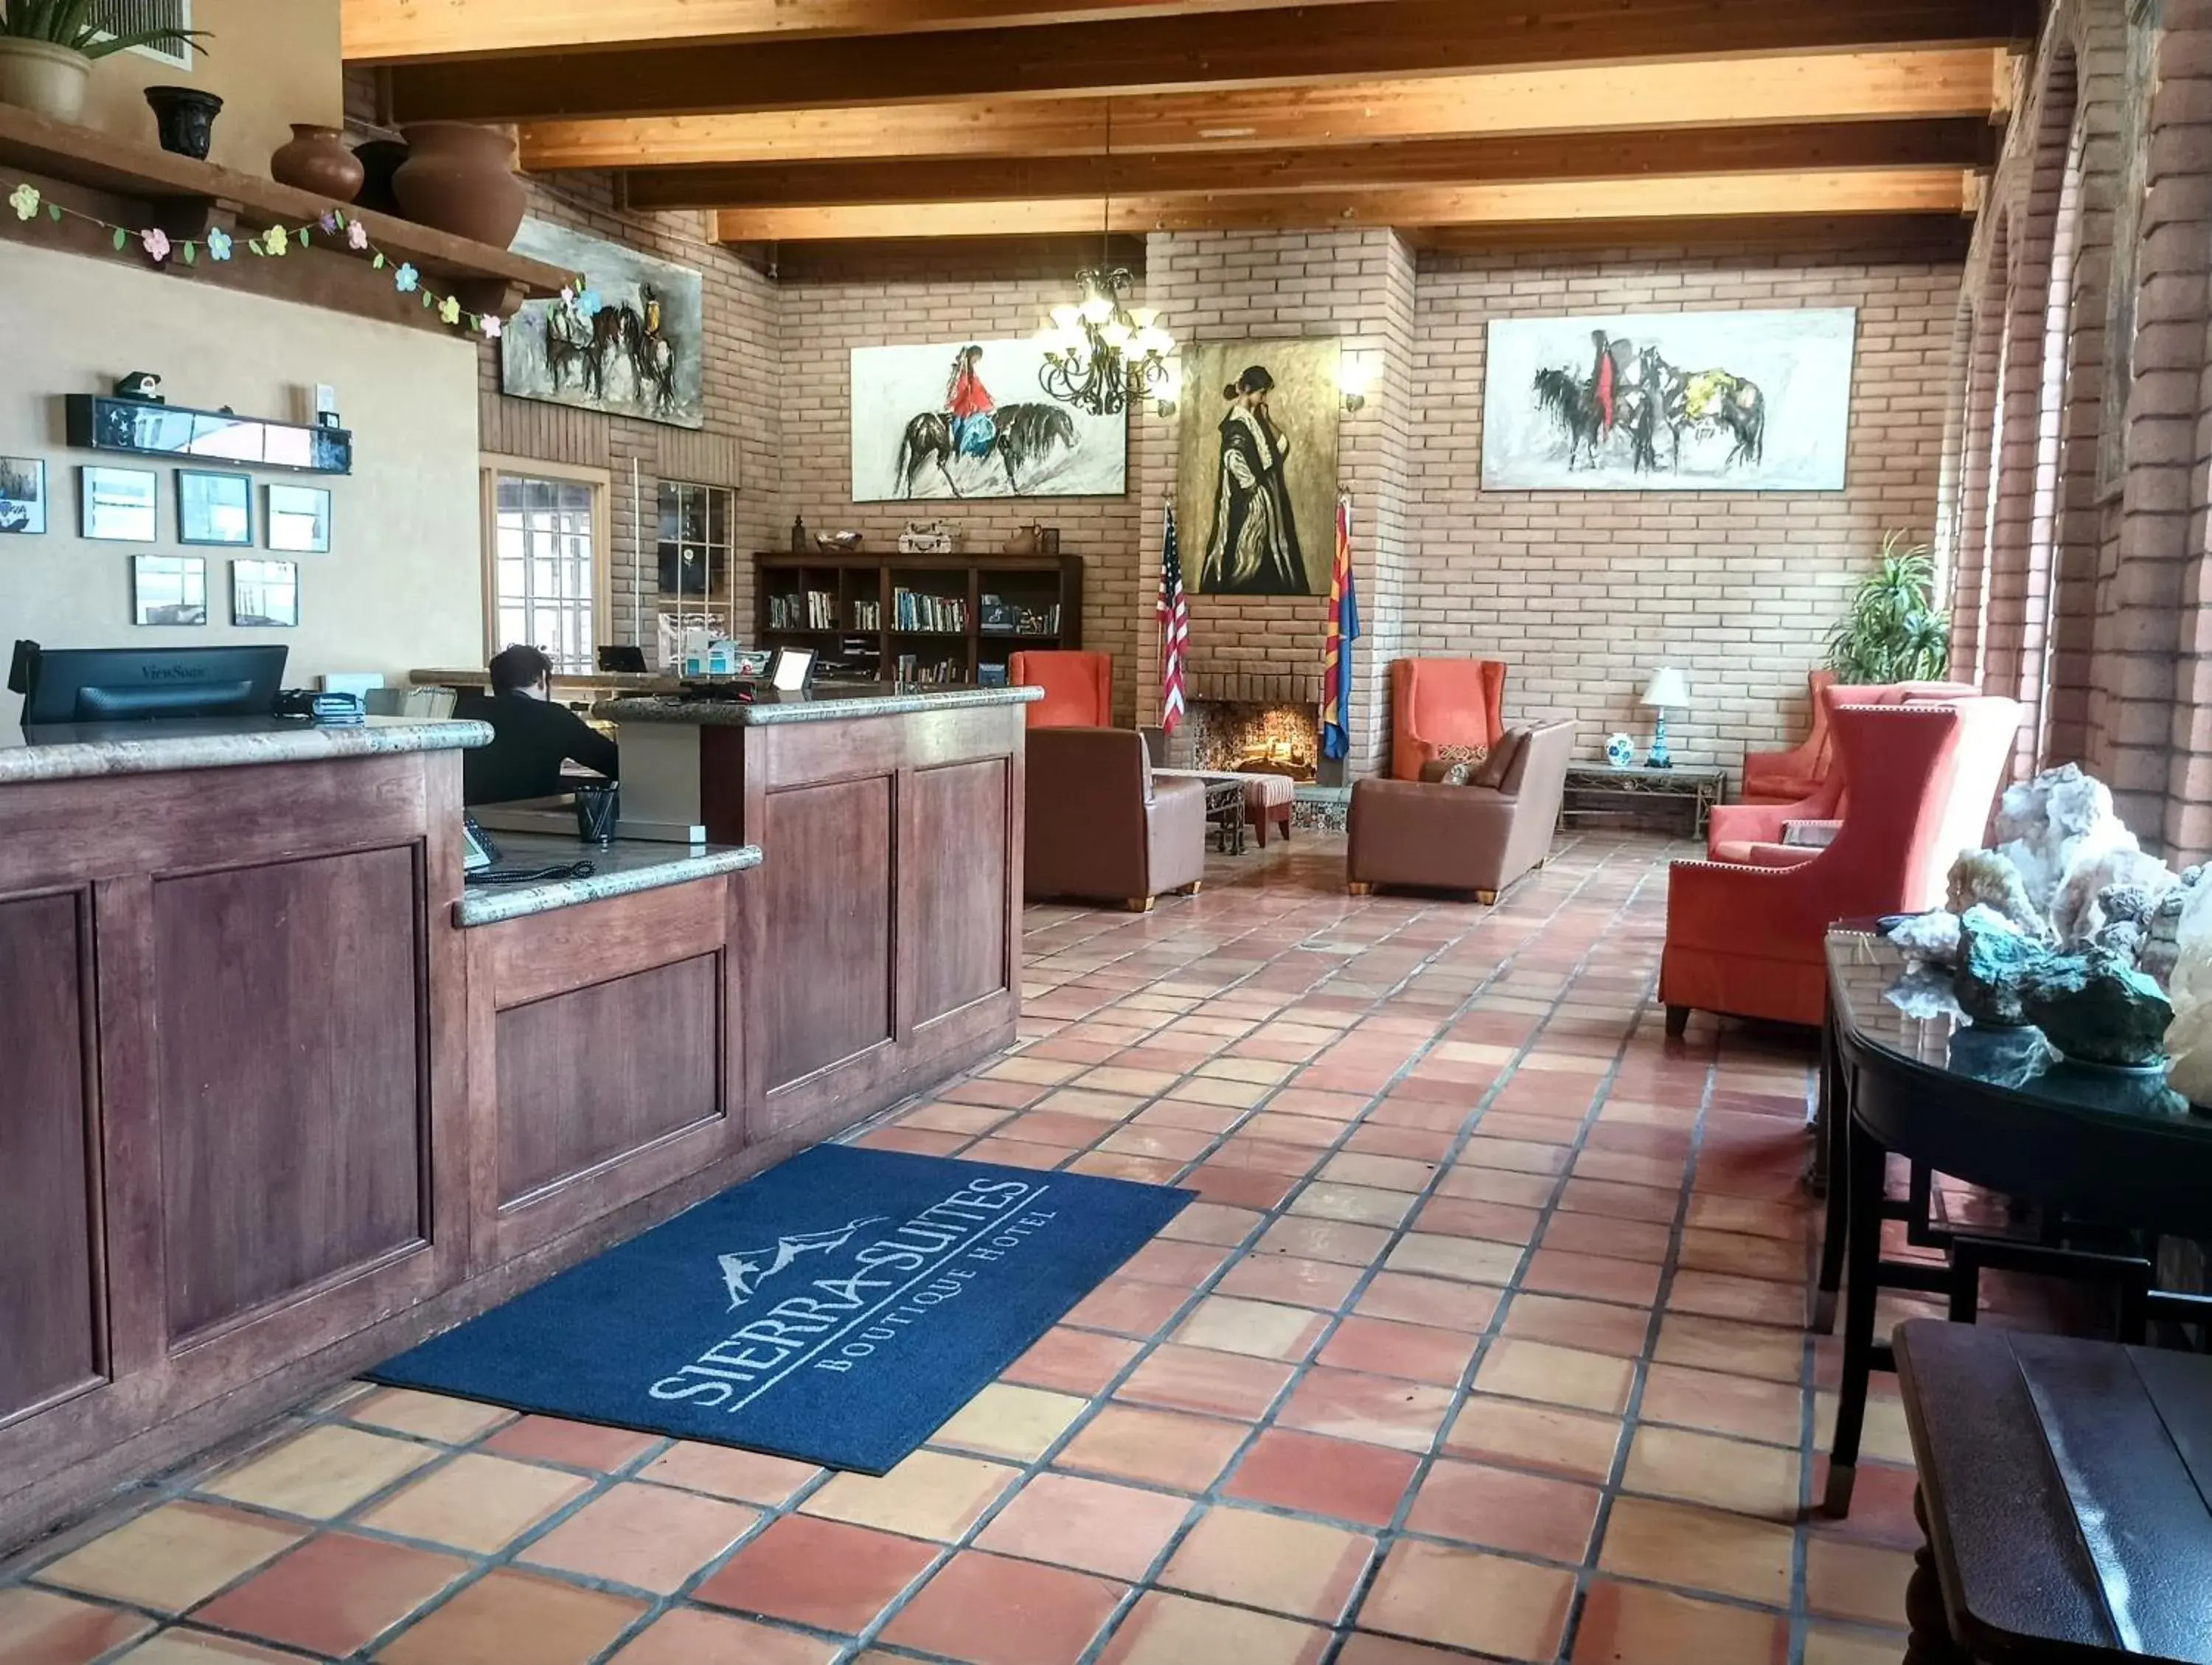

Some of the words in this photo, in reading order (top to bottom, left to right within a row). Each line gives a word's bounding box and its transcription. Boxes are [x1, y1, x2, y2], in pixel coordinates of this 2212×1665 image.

[142, 664, 206, 679] ViewSonic
[649, 1279, 892, 1406] SIERRA
[855, 1178, 1029, 1271] SUITES
[814, 1268, 977, 1372] BOUTIQUE
[967, 1211, 1057, 1261] HOTEL
